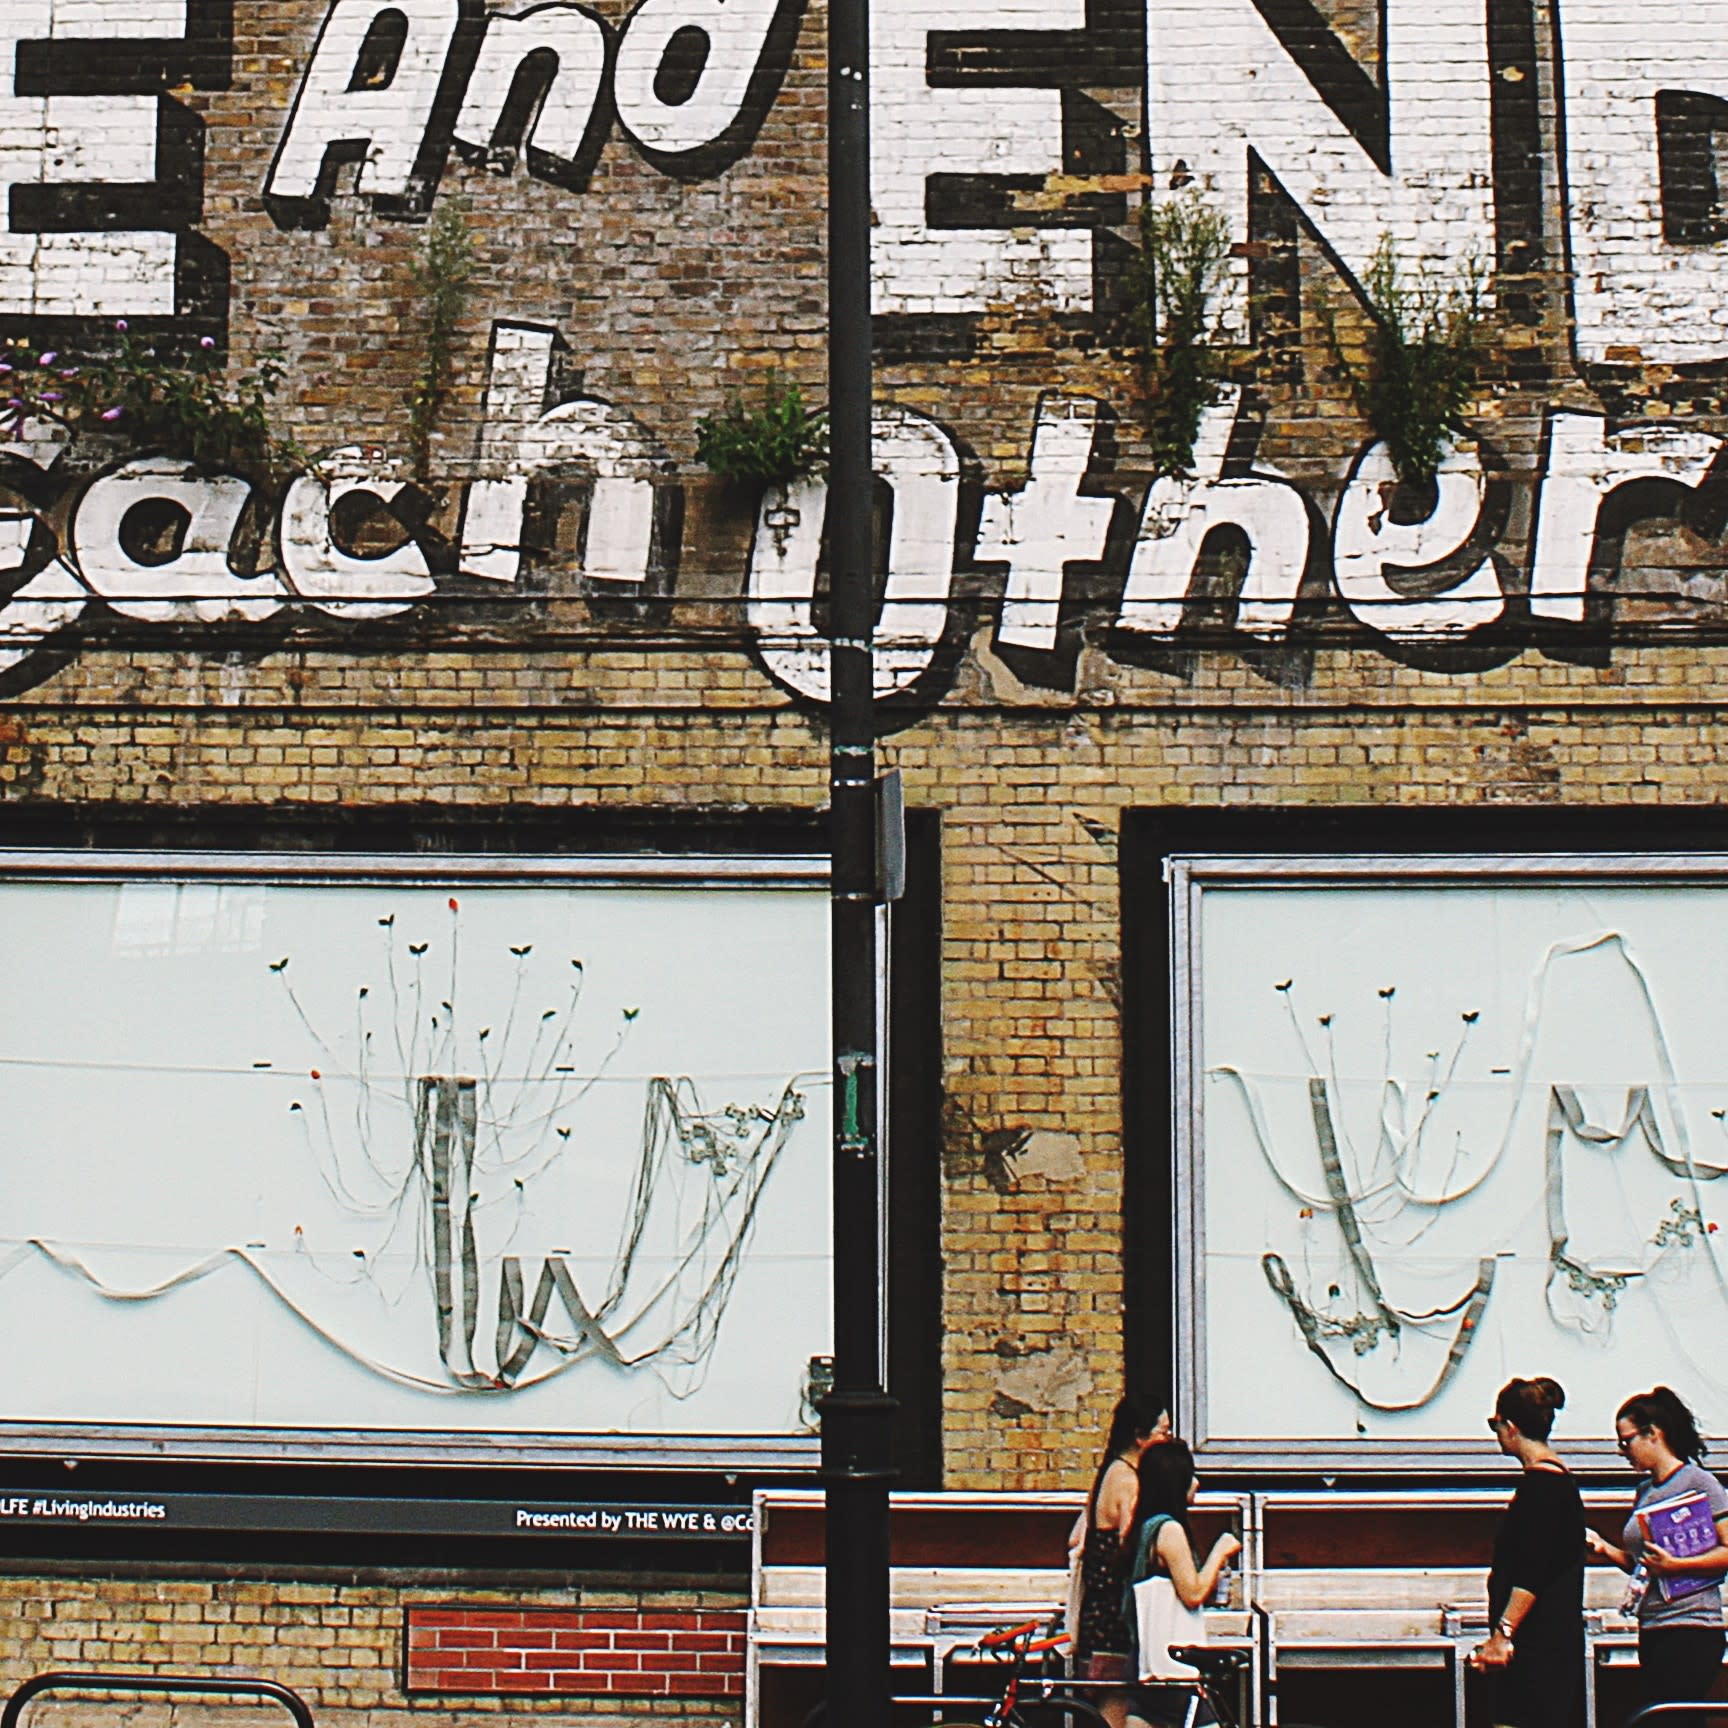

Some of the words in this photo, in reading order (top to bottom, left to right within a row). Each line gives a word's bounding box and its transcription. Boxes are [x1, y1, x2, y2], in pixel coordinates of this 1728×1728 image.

[32, 1498, 166, 1520] #LivingIndustries
[516, 1509, 597, 1528] Presented
[601, 1511, 622, 1531] by
[625, 1511, 659, 1529] THE
[662, 1512, 699, 1530] WYE
[703, 1513, 716, 1531] &
